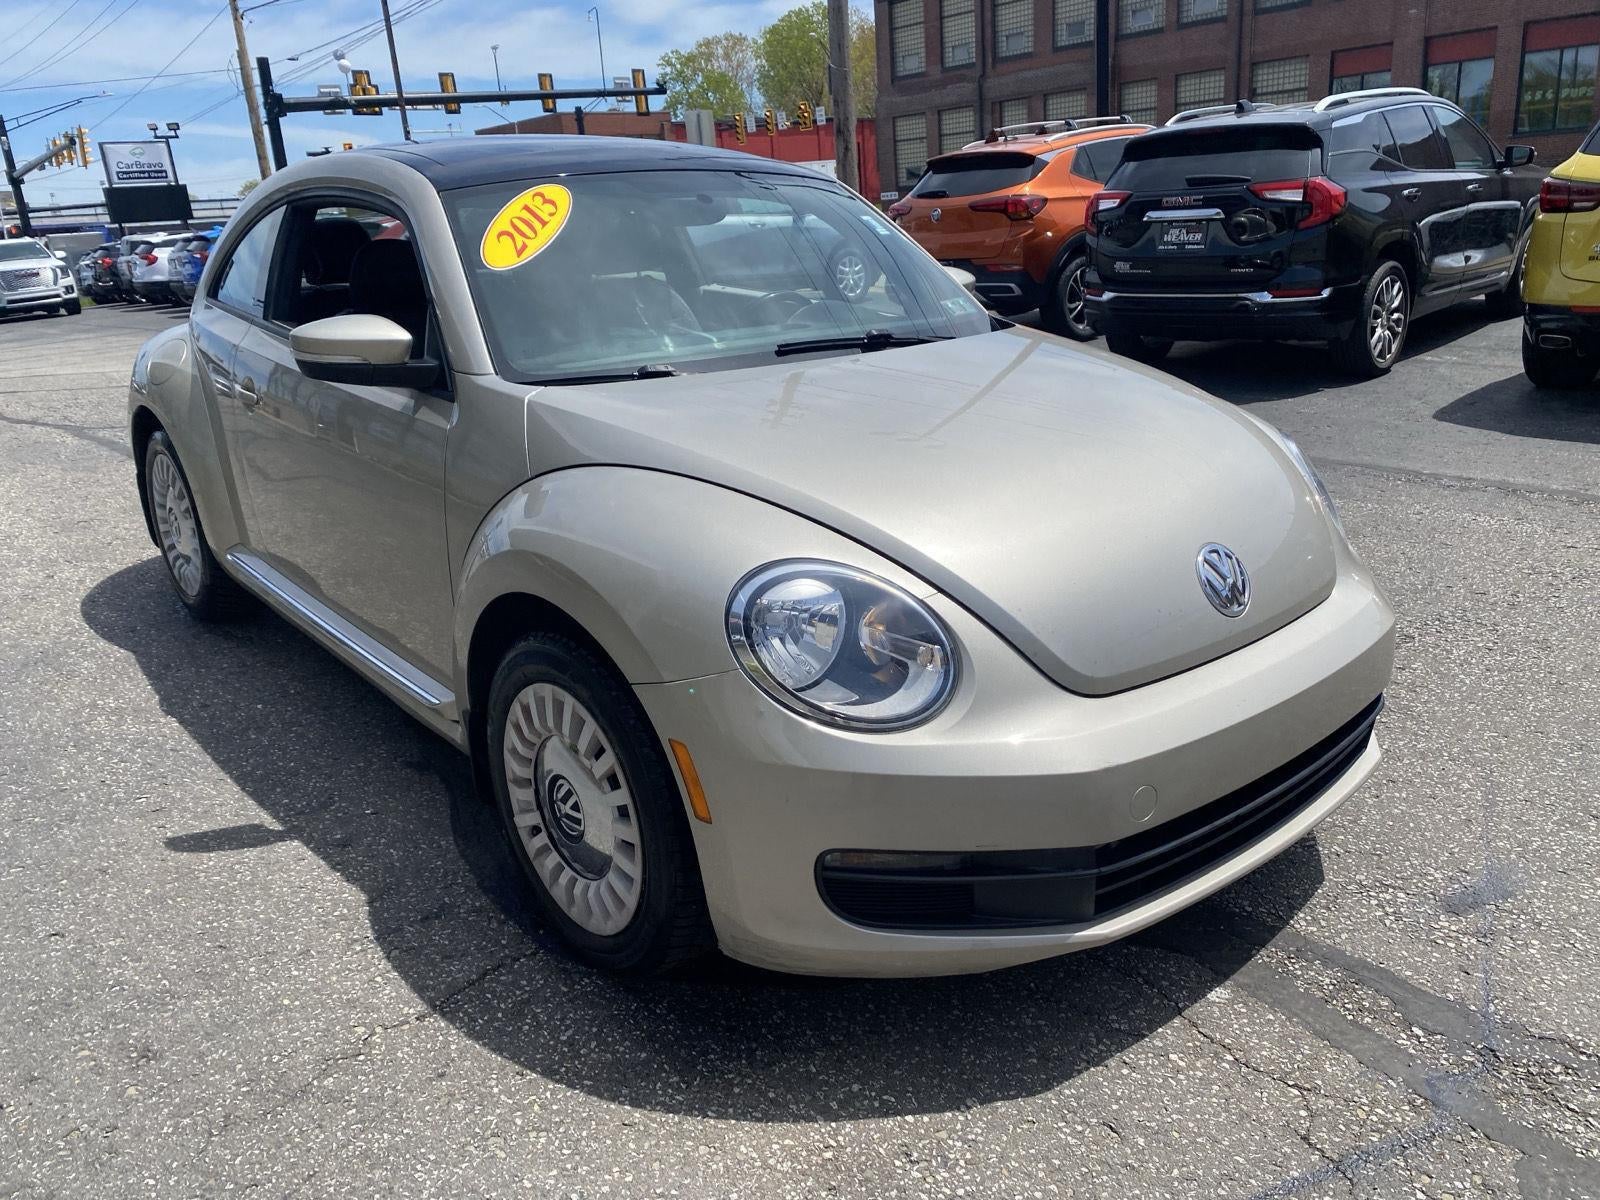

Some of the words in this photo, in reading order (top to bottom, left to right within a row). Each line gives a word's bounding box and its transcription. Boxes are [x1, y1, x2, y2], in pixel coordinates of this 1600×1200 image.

[116, 160, 164, 169] CarBravo
[118, 171, 148, 179] Certified
[1161, 194, 1204, 207] GMC
[496, 191, 558, 258] 2013
[1163, 232, 1203, 242] WEAVER
